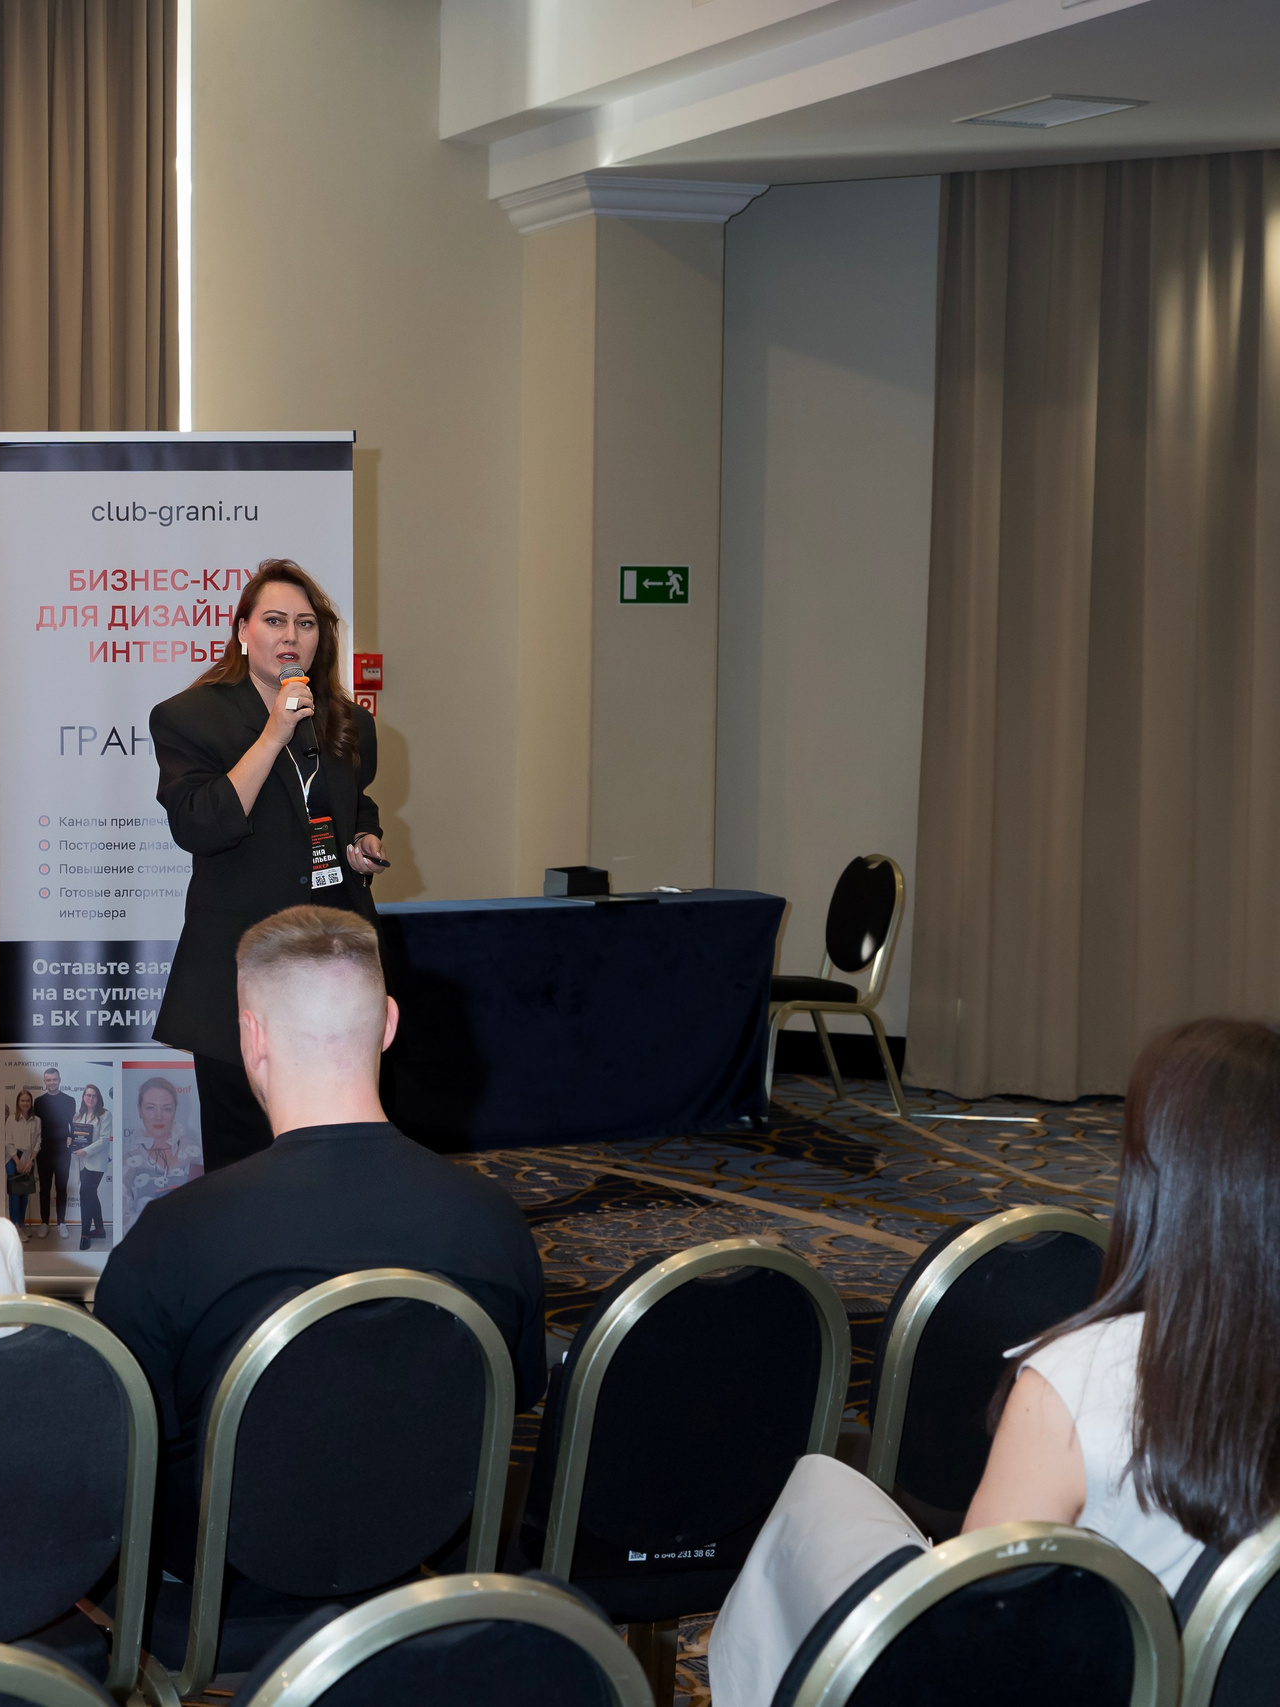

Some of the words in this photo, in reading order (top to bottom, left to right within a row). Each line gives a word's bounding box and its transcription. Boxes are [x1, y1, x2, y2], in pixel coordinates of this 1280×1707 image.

[91, 500, 259, 527] club-grani.ru
[35, 604, 98, 631] ДЛЯ
[107, 598, 234, 631] ДИЗАЙН
[89, 640, 226, 663] ИНТЕРЬЕ
[59, 725, 154, 756] ГРАН
[59, 816, 107, 827] Каналы
[59, 840, 136, 852] Построение
[59, 863, 134, 875] Повышение
[137, 865, 193, 874] стоимос
[59, 887, 111, 898] Готовые
[114, 888, 183, 900] алгоритмы
[59, 909, 127, 921] интерьера
[32, 958, 130, 975] Оставьте
[135, 961, 172, 975] зая
[32, 987, 57, 1001] на
[32, 1014, 44, 1026] в
[50, 1010, 80, 1026] БК
[86, 1010, 156, 1026] ГРАНИ
[693, 1549, 704, 1558] 38
[705, 1549, 716, 1557] 62
